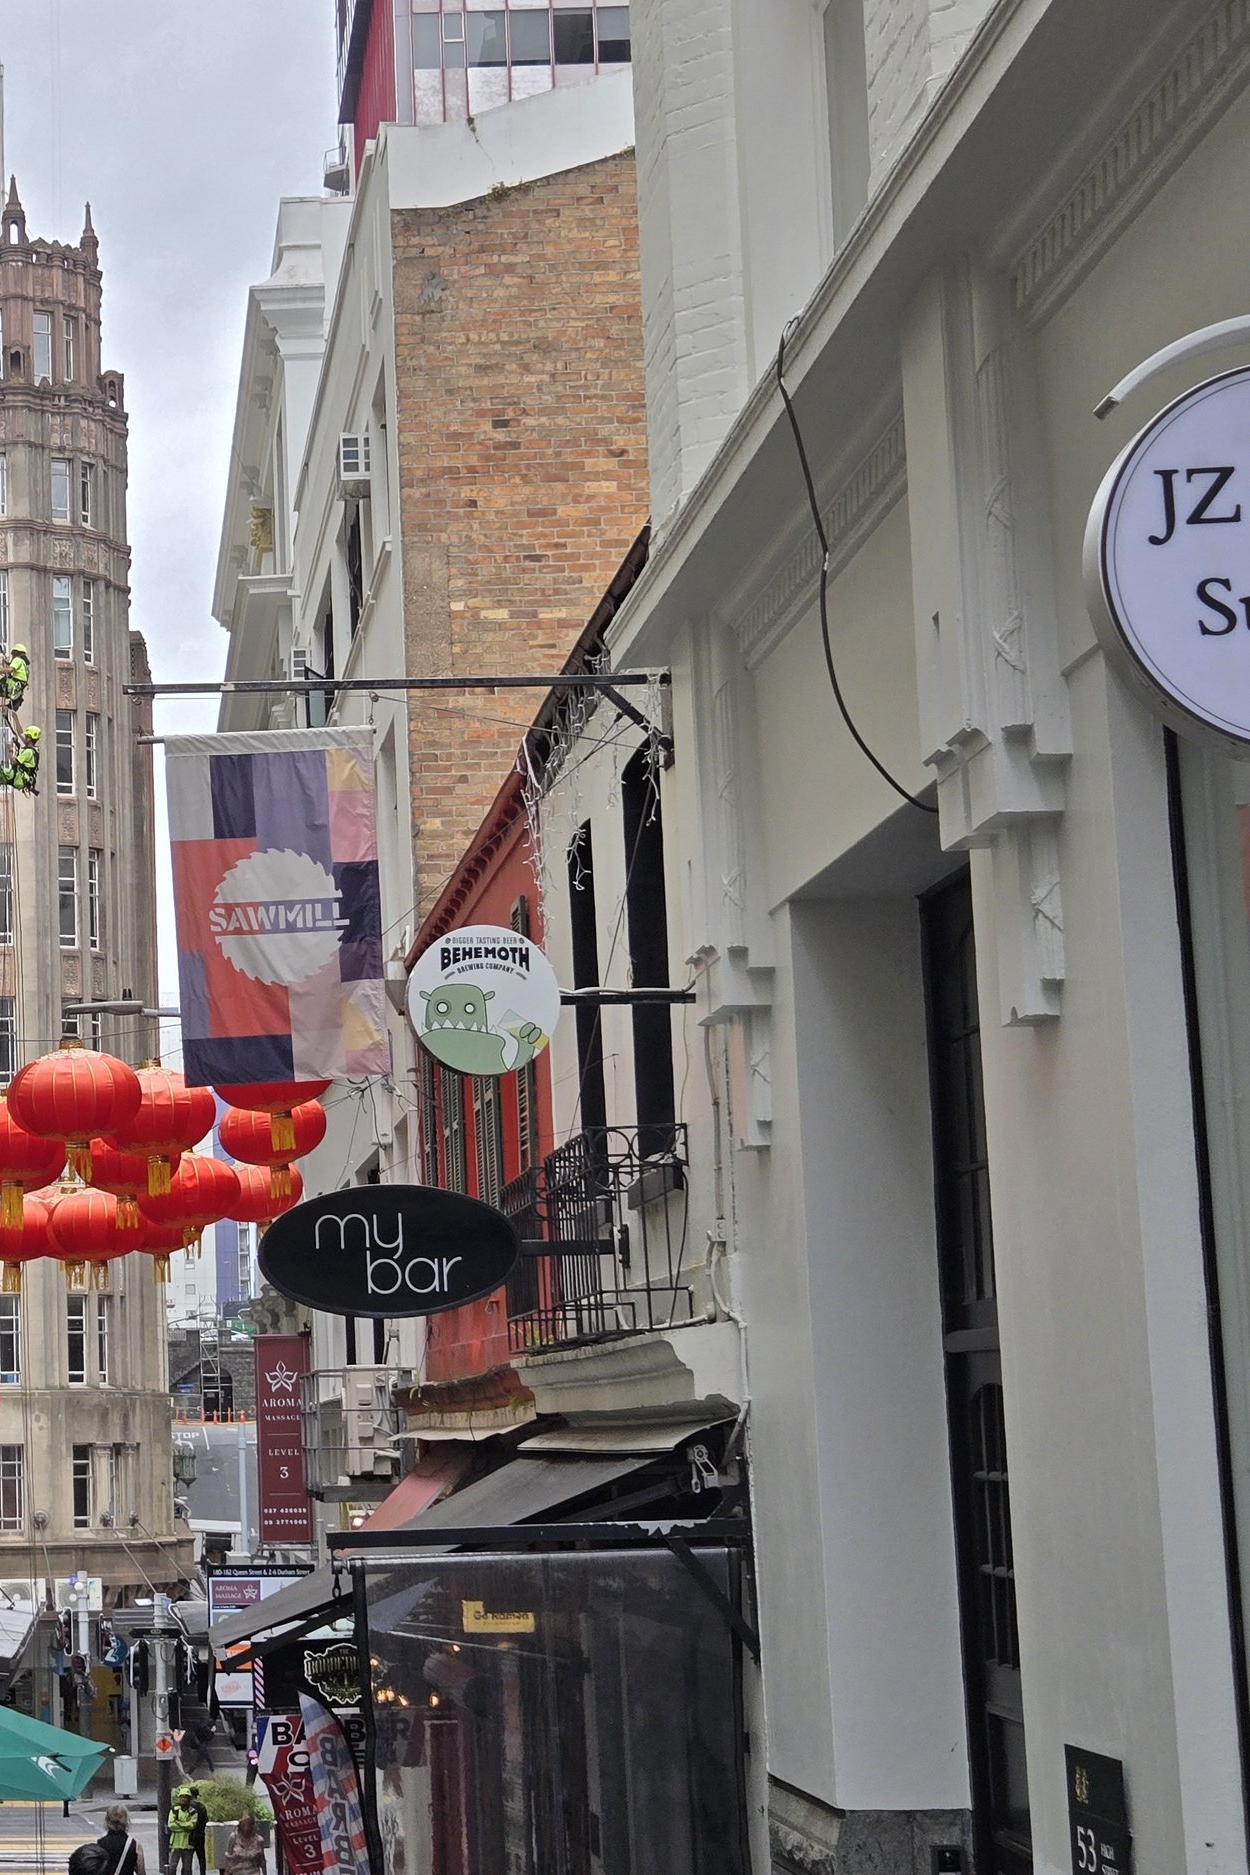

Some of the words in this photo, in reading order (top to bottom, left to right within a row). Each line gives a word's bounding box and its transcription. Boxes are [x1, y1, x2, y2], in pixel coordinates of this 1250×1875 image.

[1148, 467, 1241, 546] JZ
[209, 901, 350, 932] SAWMILL
[452, 936, 474, 945] BIGGER
[476, 936, 501, 945] TASTING
[503, 936, 518, 945] BEER
[440, 946, 530, 973] BEHEMOTH
[457, 962, 484, 974] BREWING
[486, 962, 514, 974] COMPANY
[315, 1213, 404, 1260] my
[367, 1248, 463, 1295] bar
[262, 1399, 302, 1408] AROMA
[279, 1466, 289, 1479] 3
[292, 1834, 319, 1845] LEVEL
[1077, 1825, 1097, 1872] 53
[304, 1843, 316, 1858] 3
